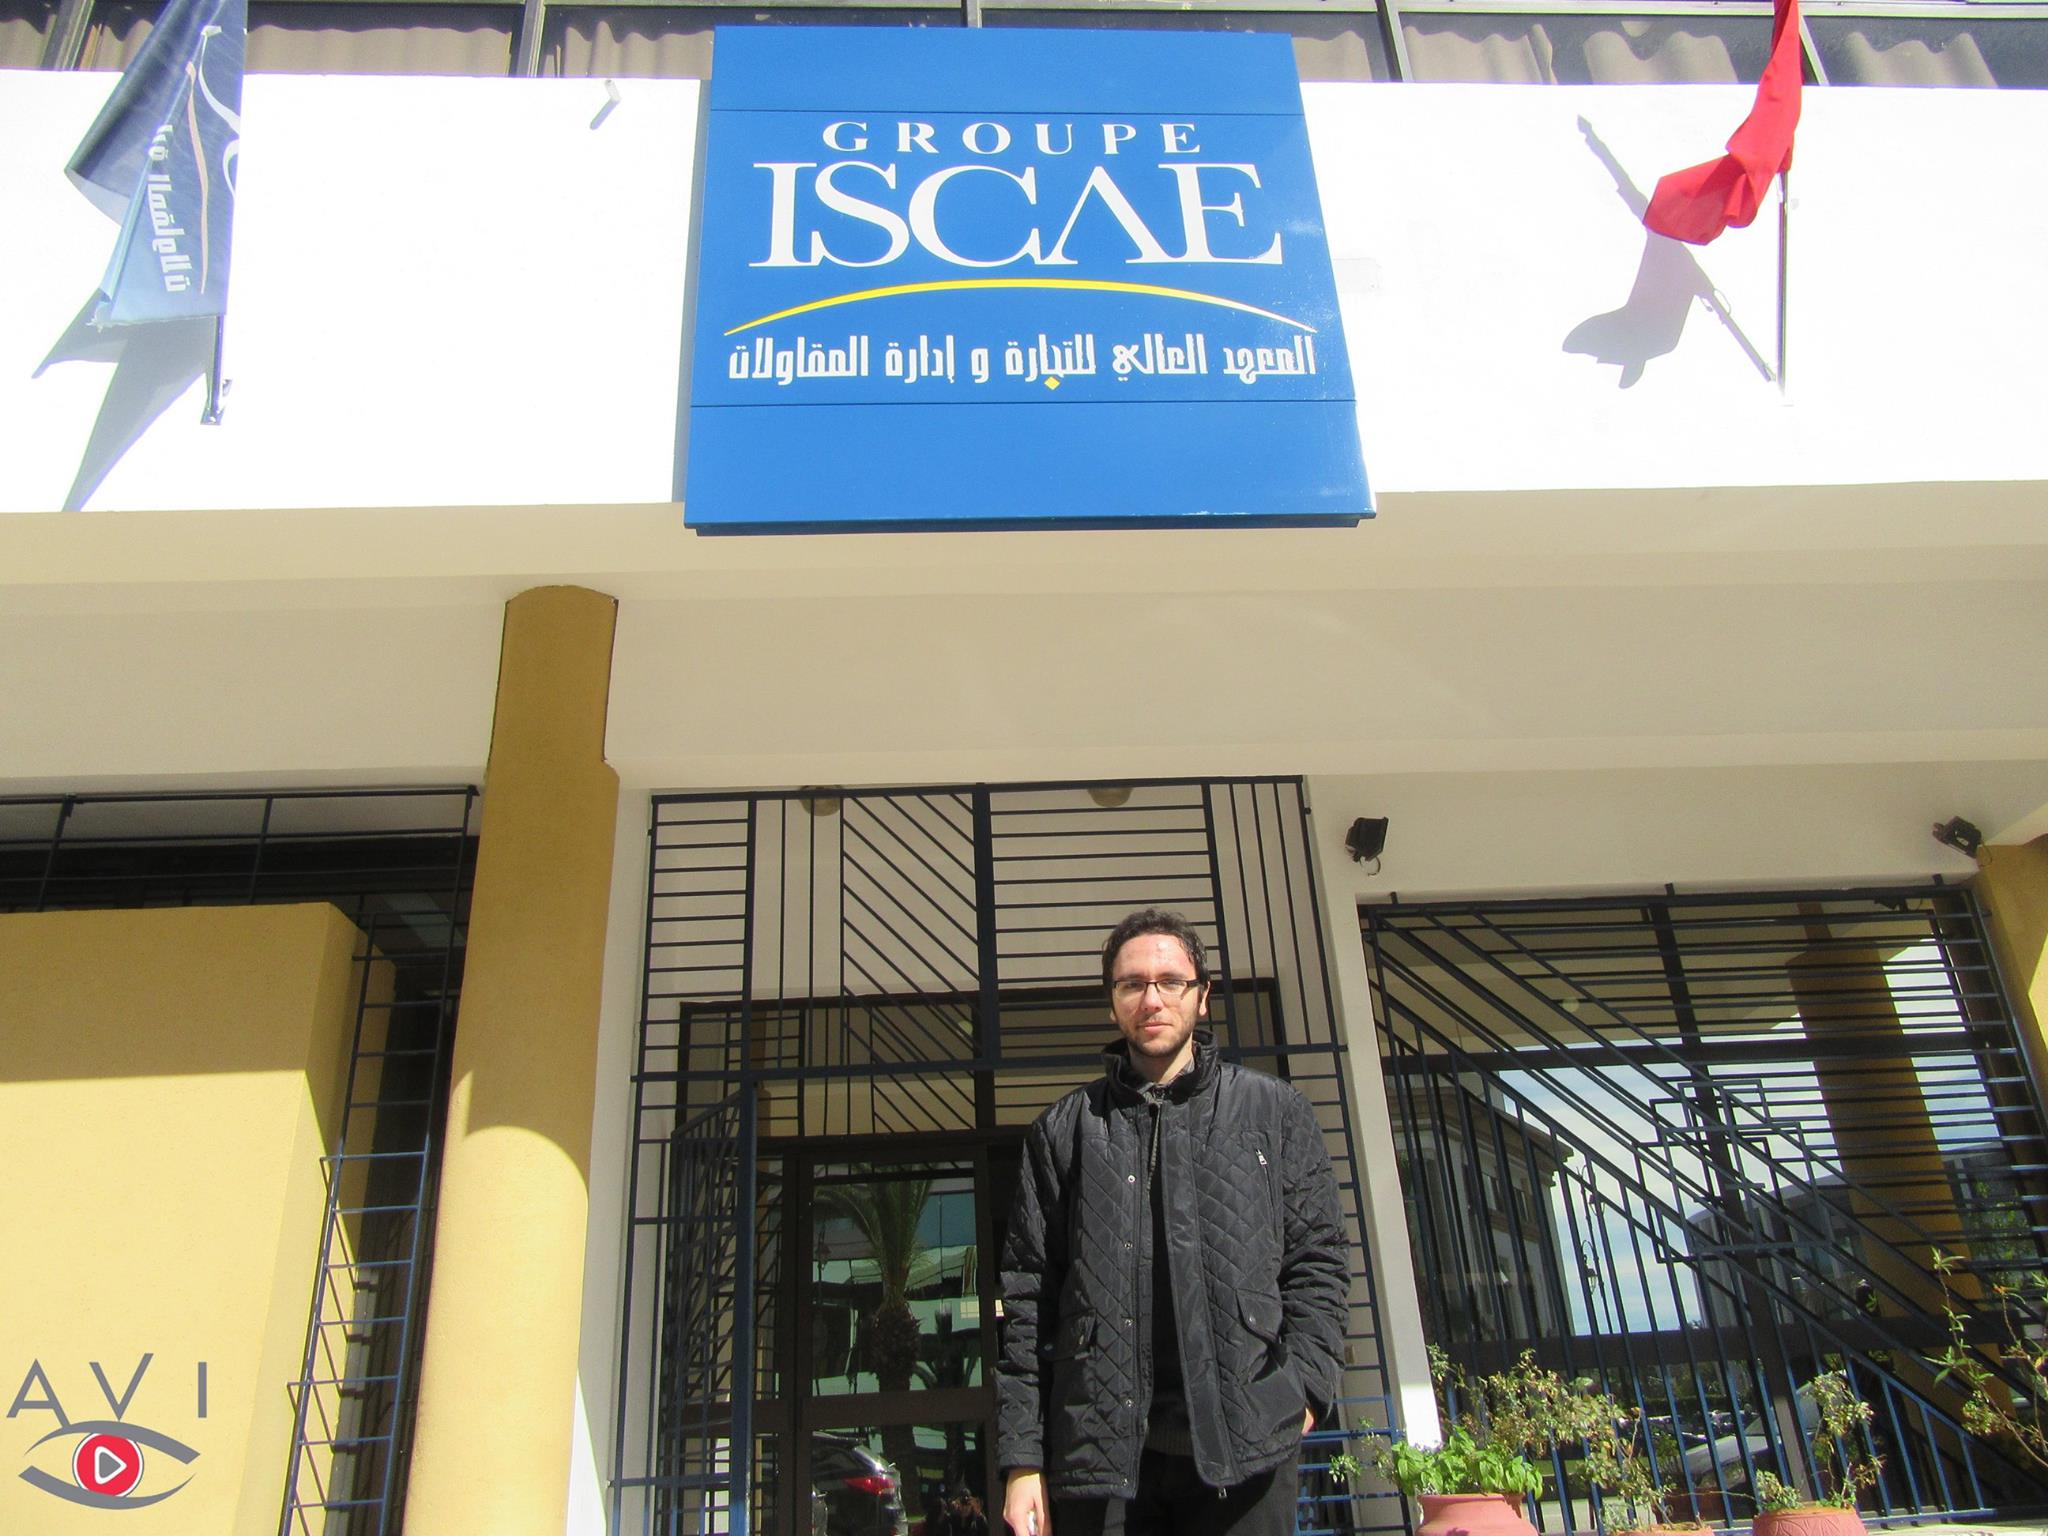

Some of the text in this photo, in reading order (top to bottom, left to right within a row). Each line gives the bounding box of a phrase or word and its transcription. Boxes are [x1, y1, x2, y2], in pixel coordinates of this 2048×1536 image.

[823, 121, 1201, 154] GROUPE
[748, 161, 1283, 267] ISCAE
[728, 333, 1317, 390] المعهد العالي للتجارة و إدارة المقاولات
